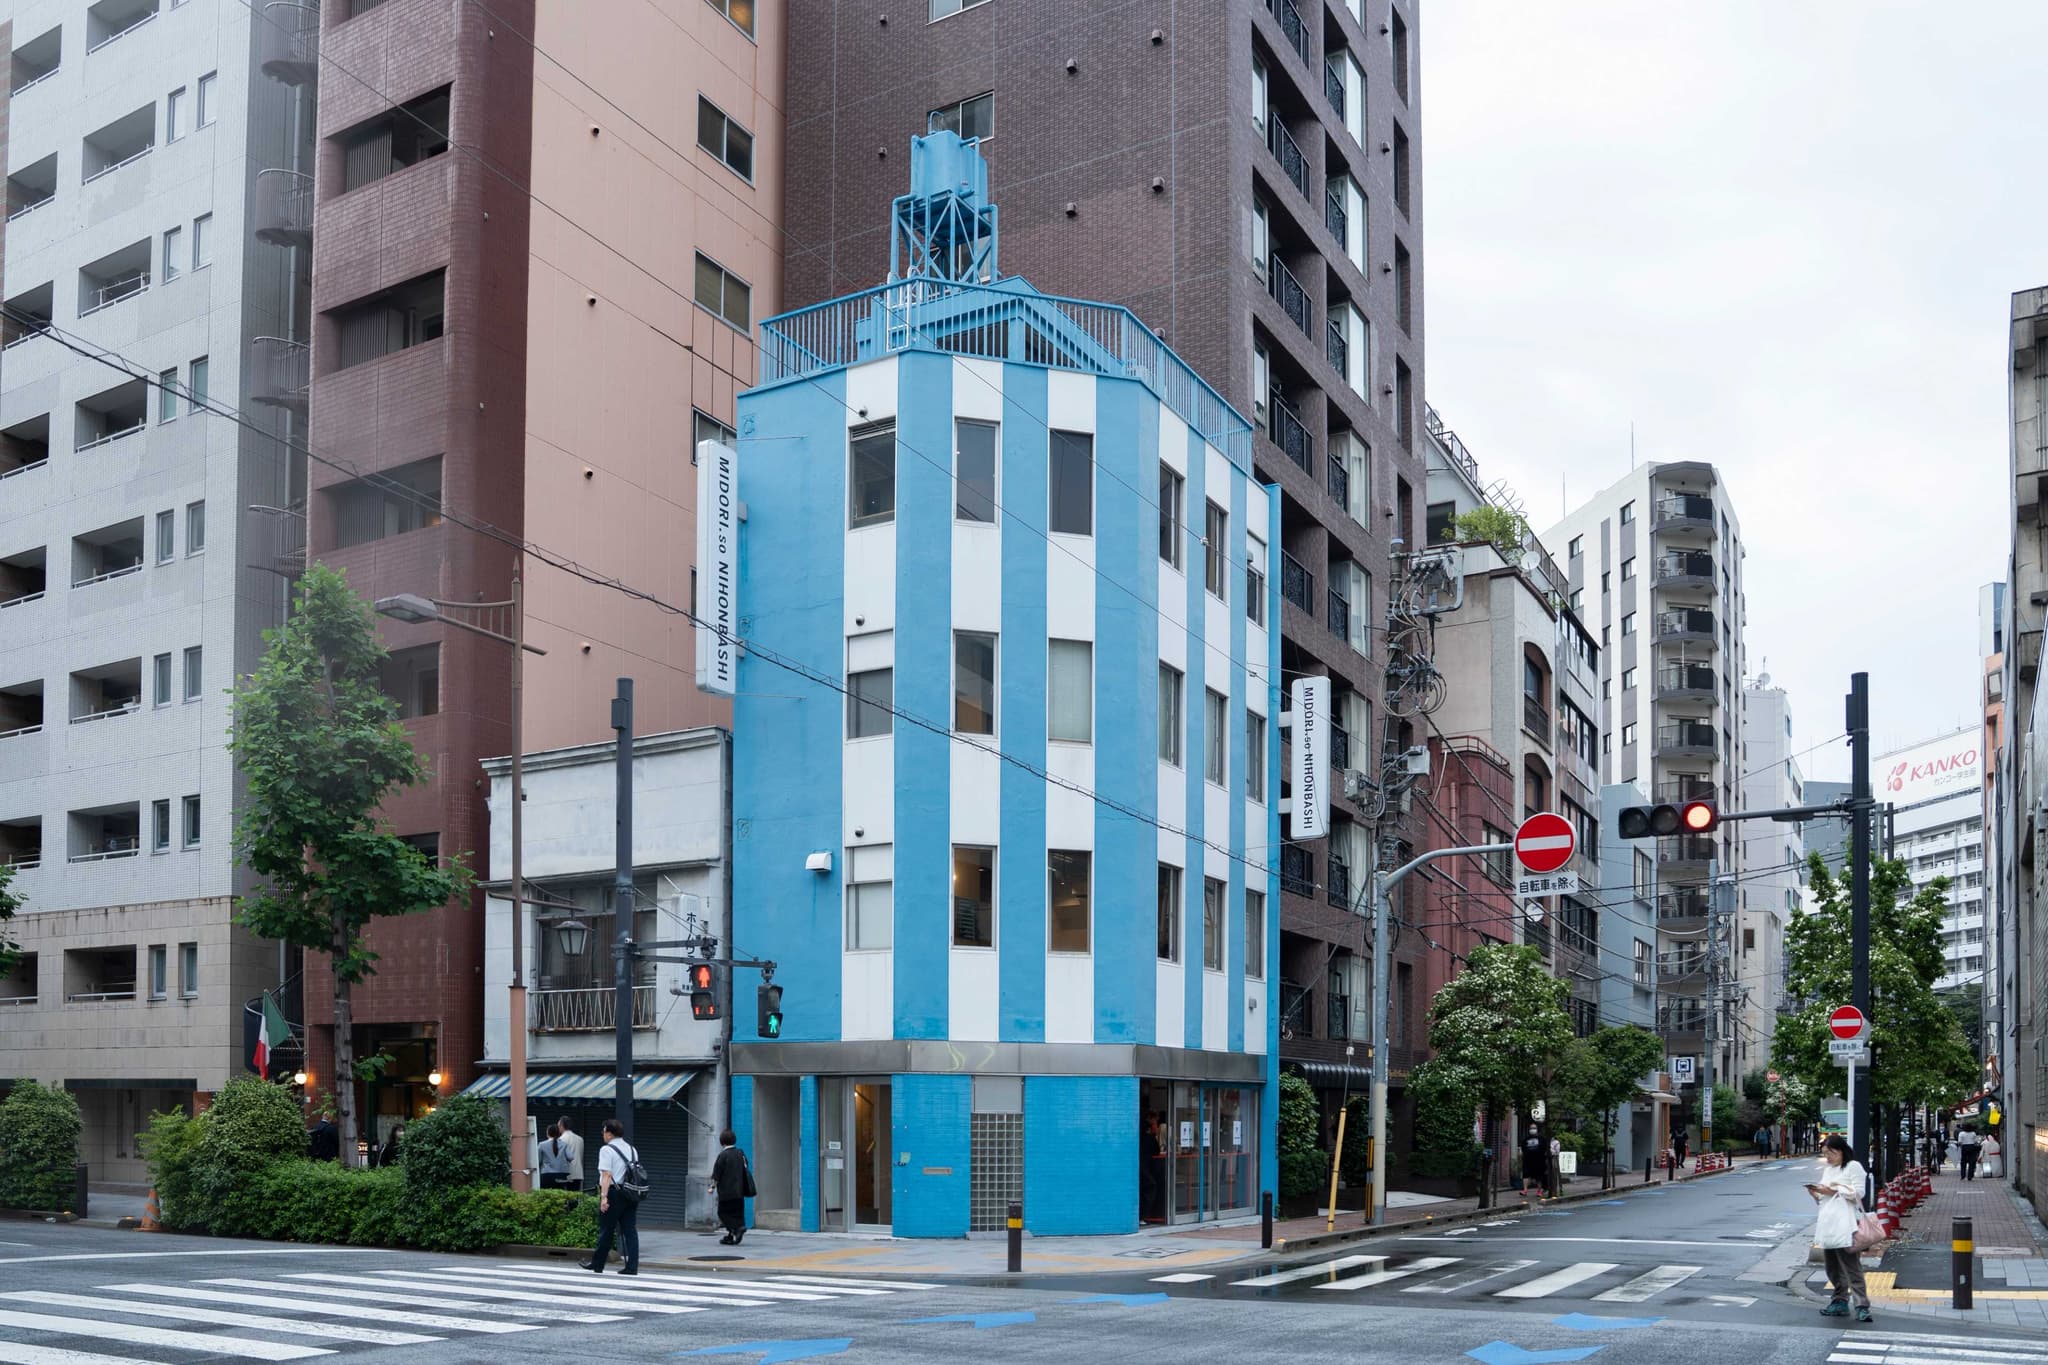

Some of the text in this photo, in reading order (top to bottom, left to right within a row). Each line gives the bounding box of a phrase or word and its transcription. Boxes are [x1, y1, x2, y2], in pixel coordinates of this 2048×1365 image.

[717, 456, 730, 682] MIDORI.so NIHONBASHI
[1303, 753, 1313, 829] NIHONBASHI
[1910, 749, 1977, 782] KANKO
[1519, 877, 1575, 894] 自転車を除く
